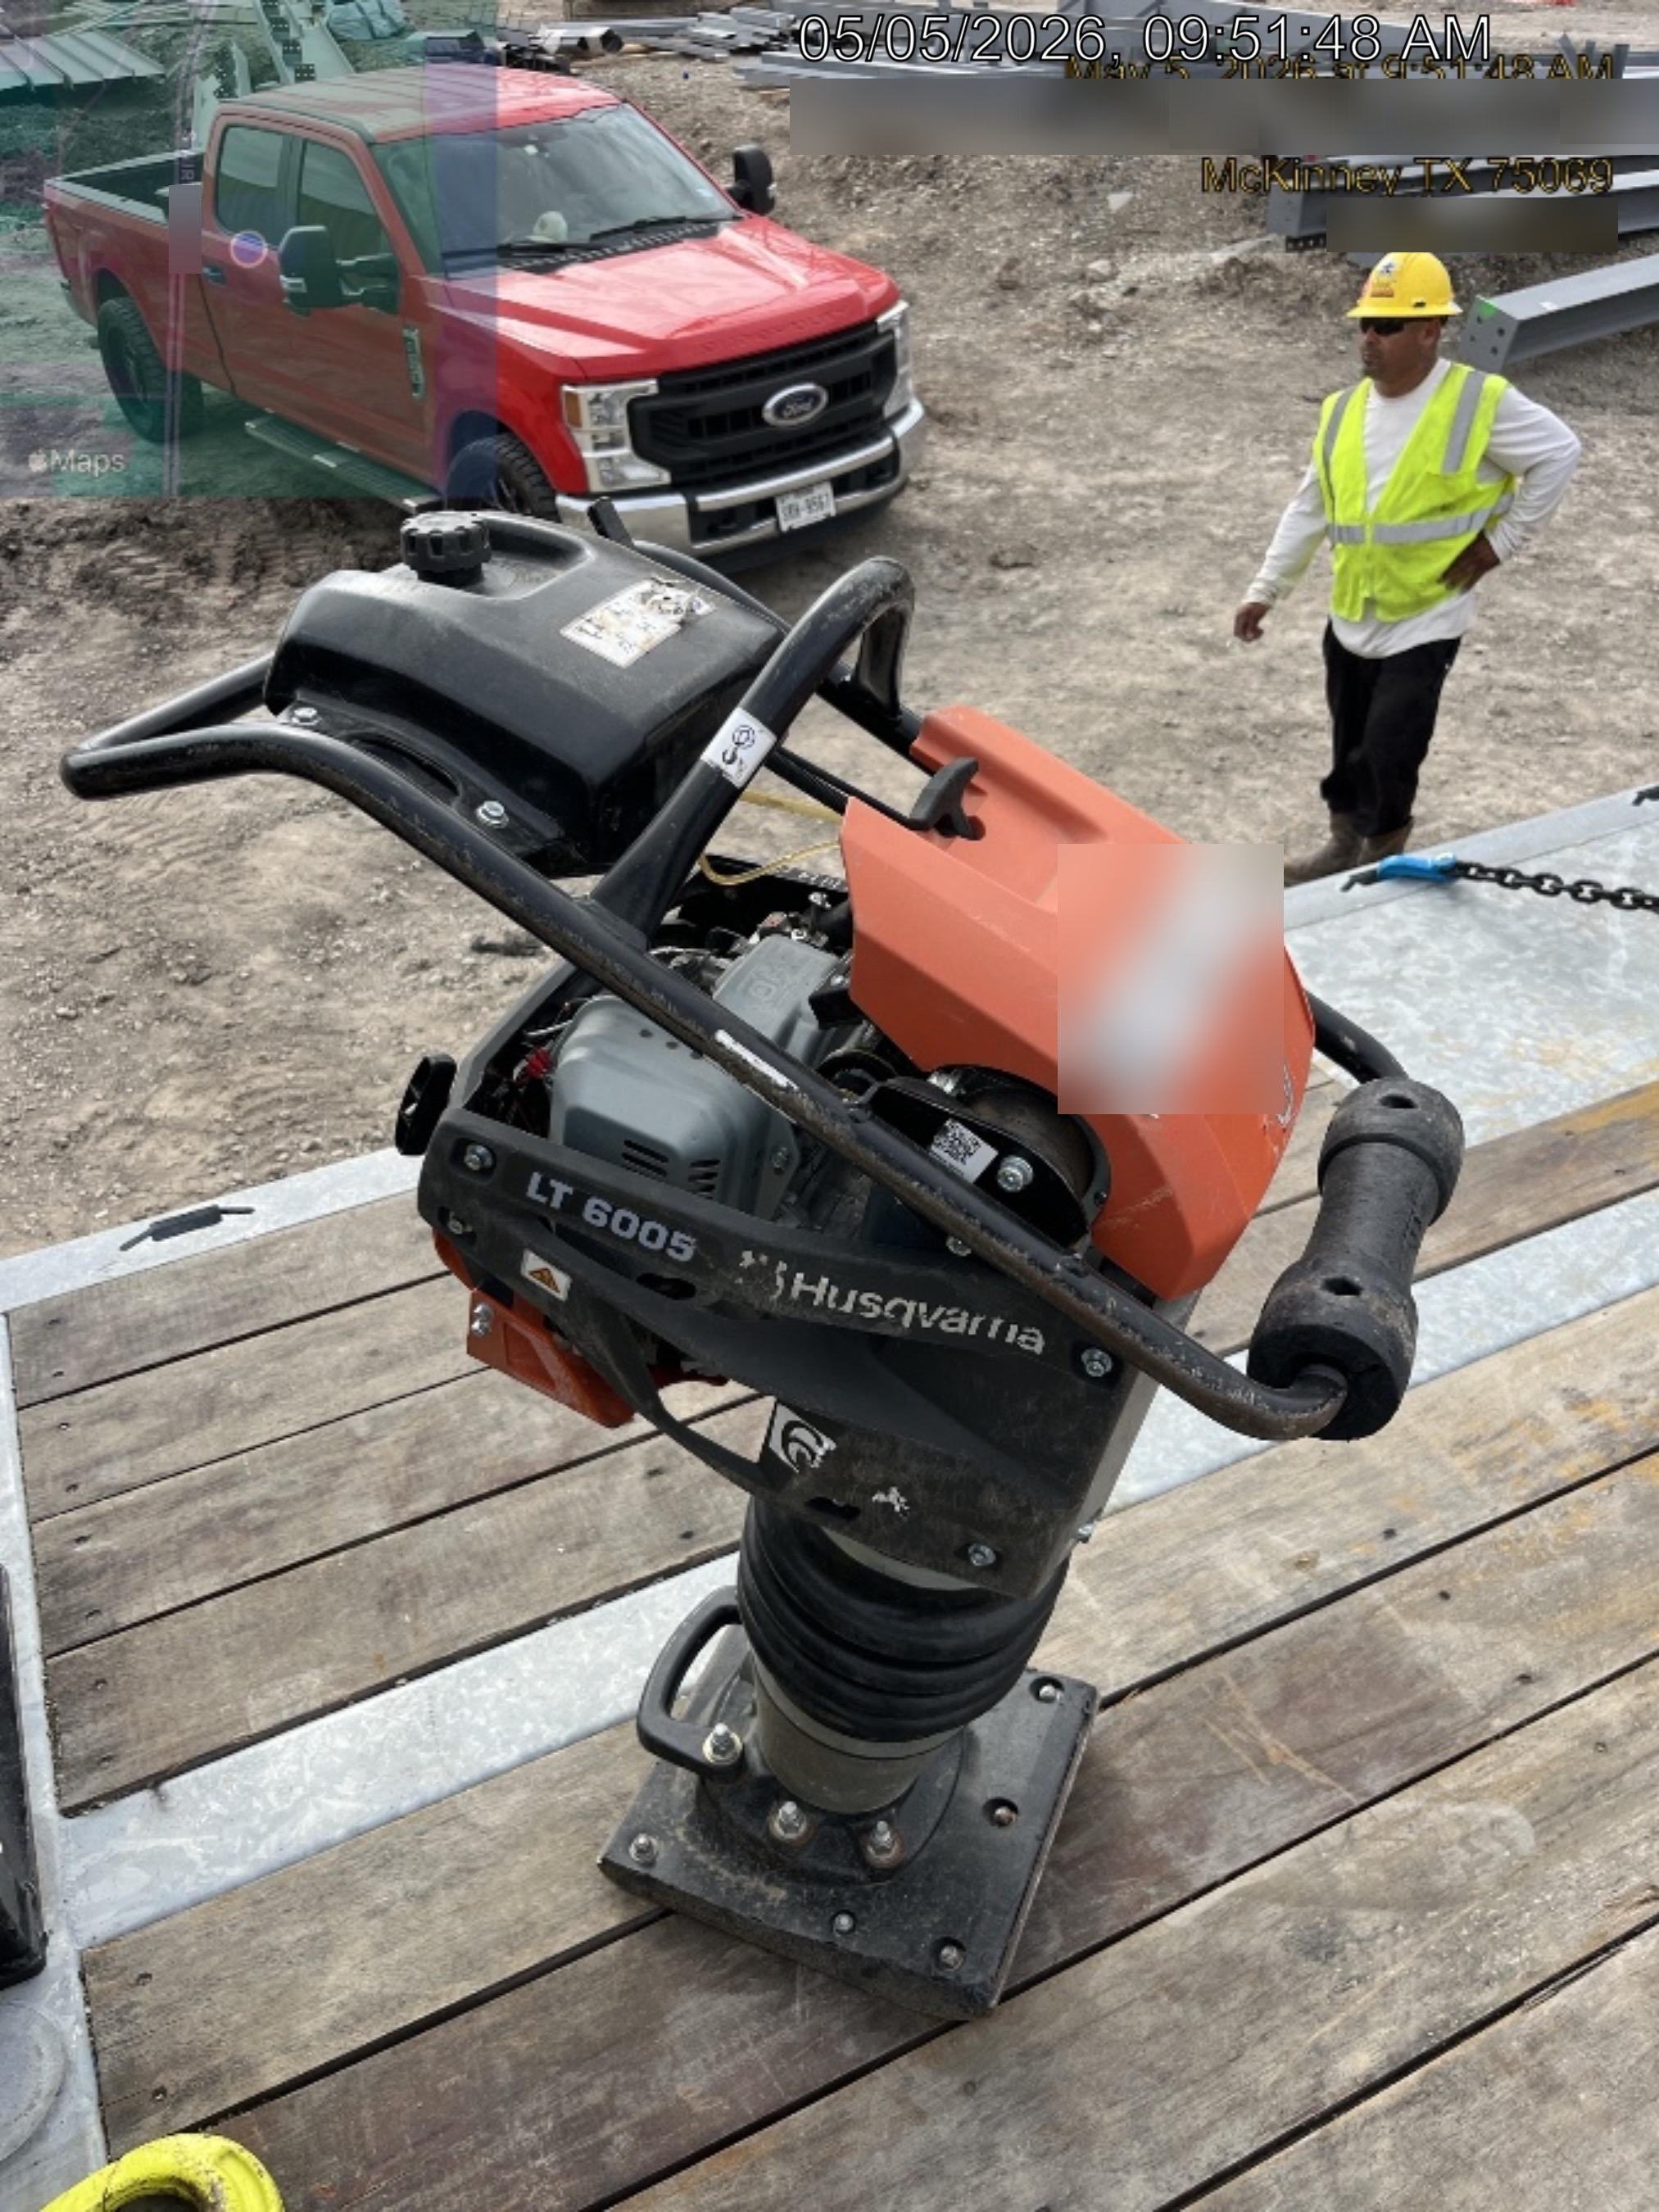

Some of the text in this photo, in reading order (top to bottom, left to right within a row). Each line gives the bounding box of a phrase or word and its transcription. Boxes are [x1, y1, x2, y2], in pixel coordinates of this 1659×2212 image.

[525, 1172, 698, 1262] LT 6005
[790, 1271, 1045, 1355] Husqvarna
